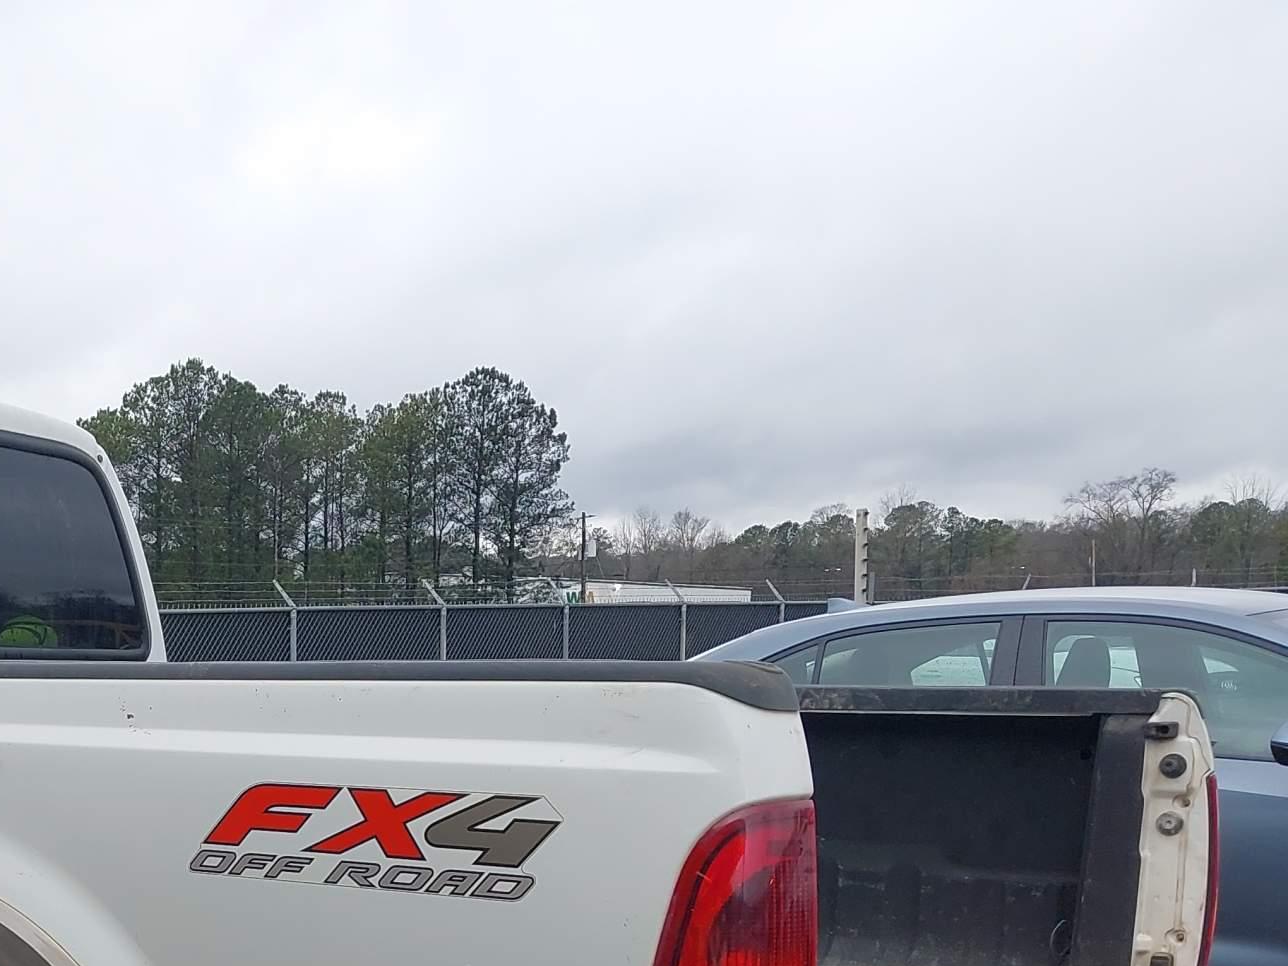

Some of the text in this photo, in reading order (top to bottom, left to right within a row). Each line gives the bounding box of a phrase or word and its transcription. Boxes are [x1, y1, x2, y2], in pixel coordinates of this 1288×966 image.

[203, 783, 562, 869] FX4
[189, 849, 535, 901] OFF ROAD
